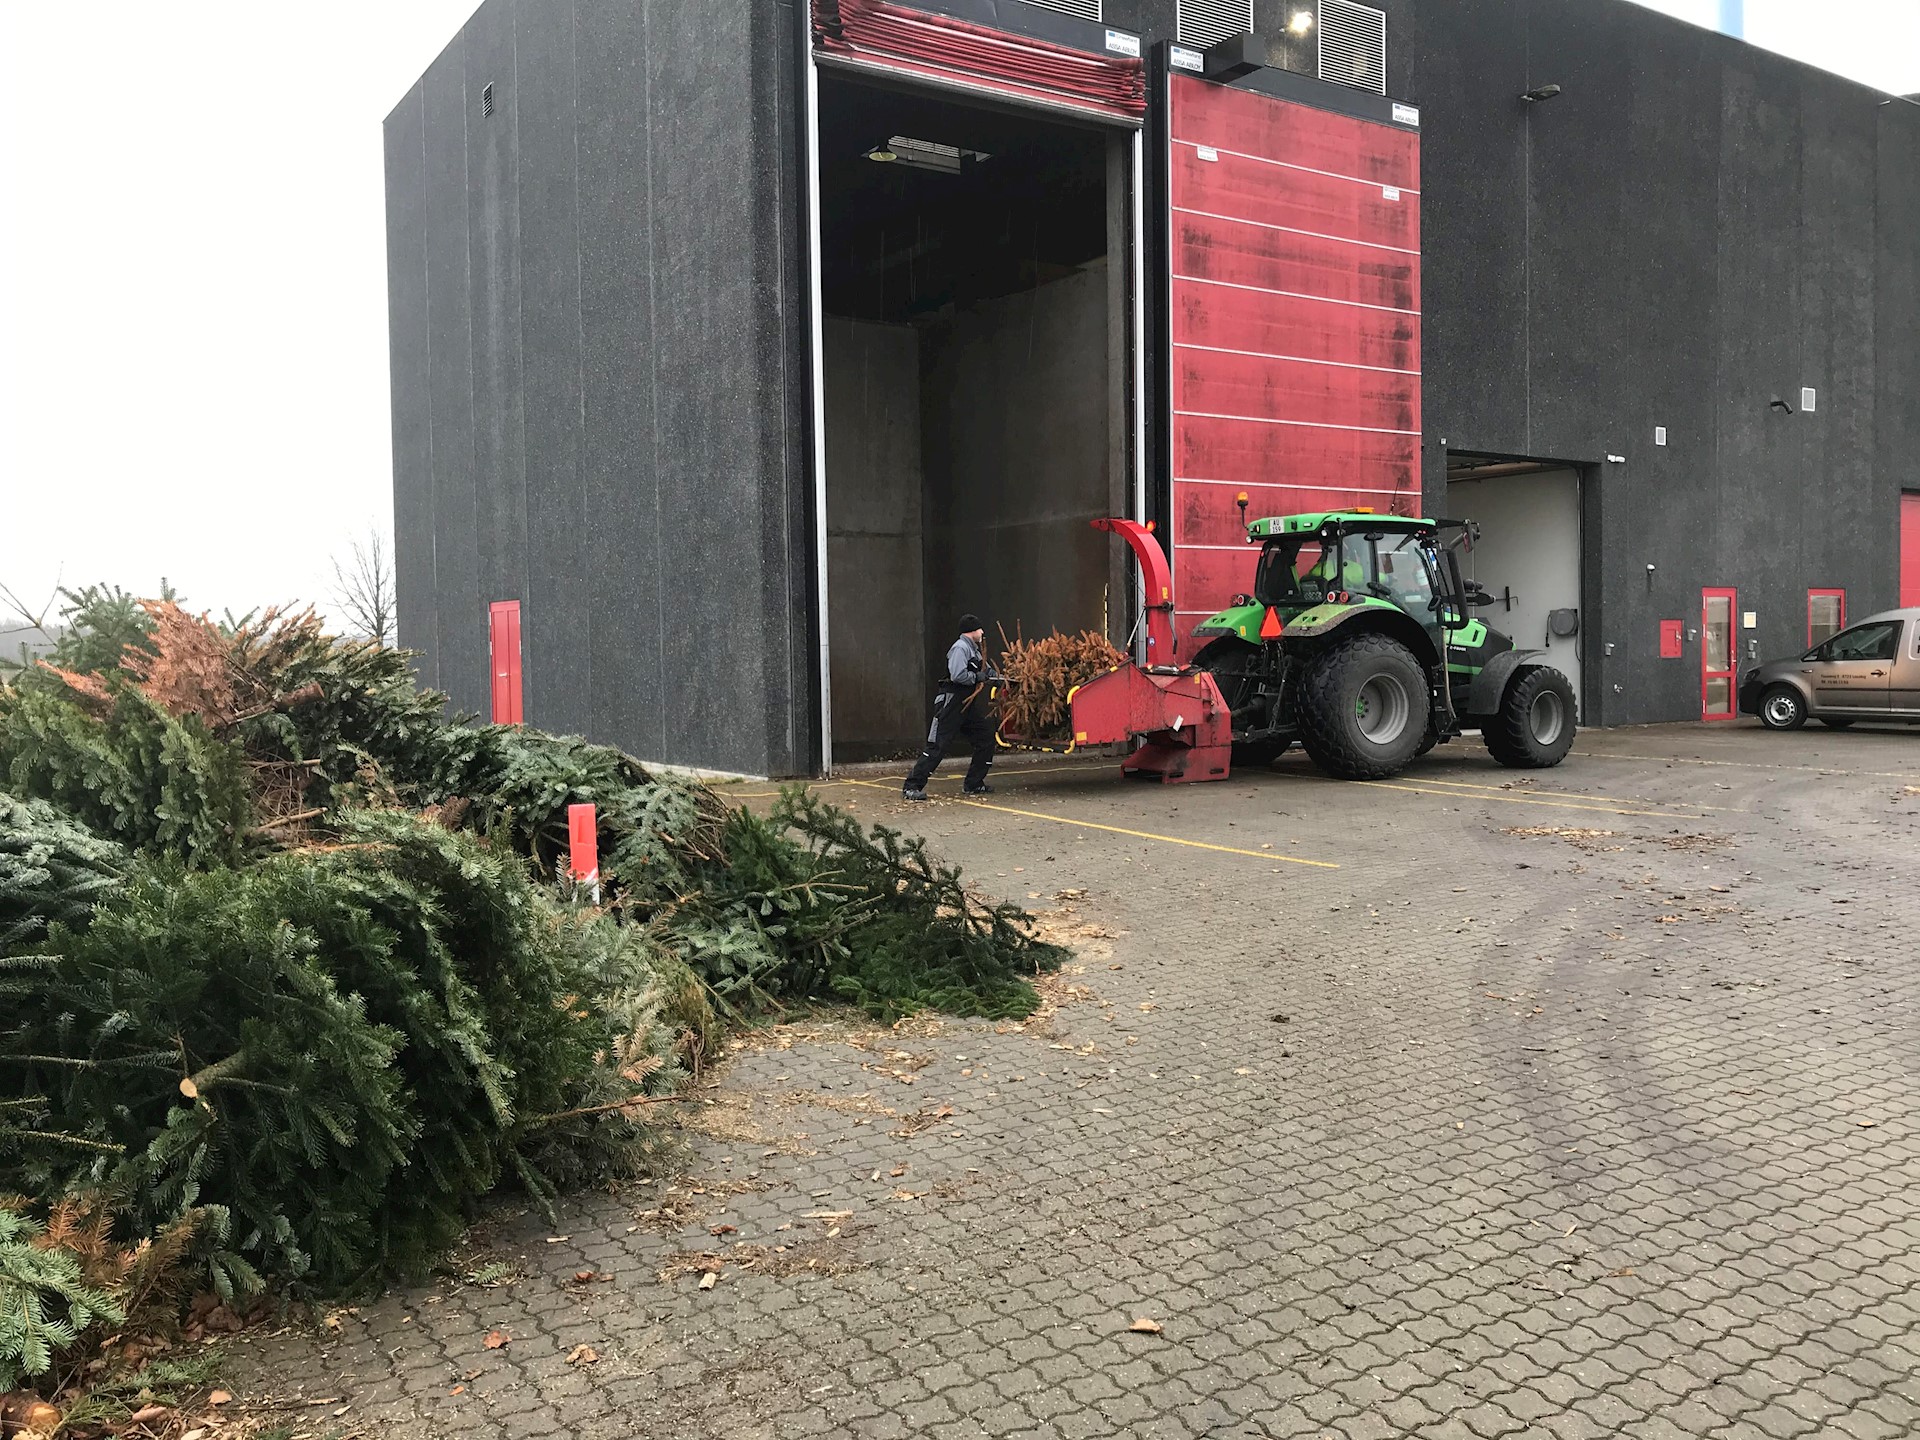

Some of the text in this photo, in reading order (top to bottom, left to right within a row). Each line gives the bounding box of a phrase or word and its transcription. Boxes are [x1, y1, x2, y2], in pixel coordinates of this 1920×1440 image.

[1108, 43, 1138, 55] ASSA ABLOY
[1173, 58, 1202, 71] ASSA ABLOY
